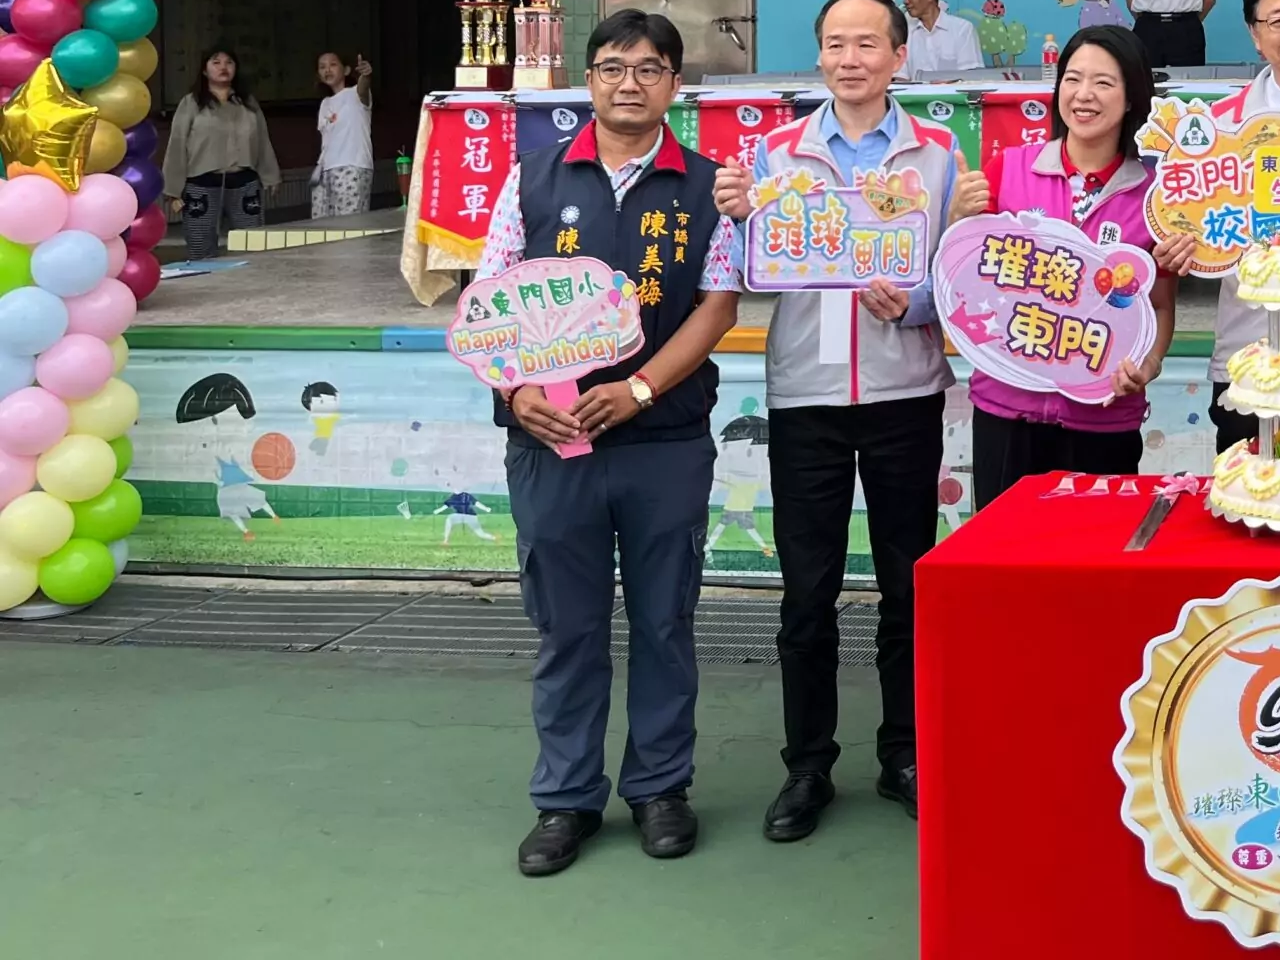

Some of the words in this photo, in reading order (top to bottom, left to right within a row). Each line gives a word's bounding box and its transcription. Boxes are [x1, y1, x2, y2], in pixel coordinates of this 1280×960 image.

[458, 135, 493, 223] 冠軍
[556, 226, 581, 254] 陳
[636, 209, 669, 306] 陳美梅
[673, 211, 691, 264] 市議員
[490, 271, 605, 318] 東門國小
[978, 234, 1086, 304] 璀璨
[452, 323, 522, 355] Happy
[517, 330, 621, 377] birthday
[1006, 301, 1112, 373] 東門
